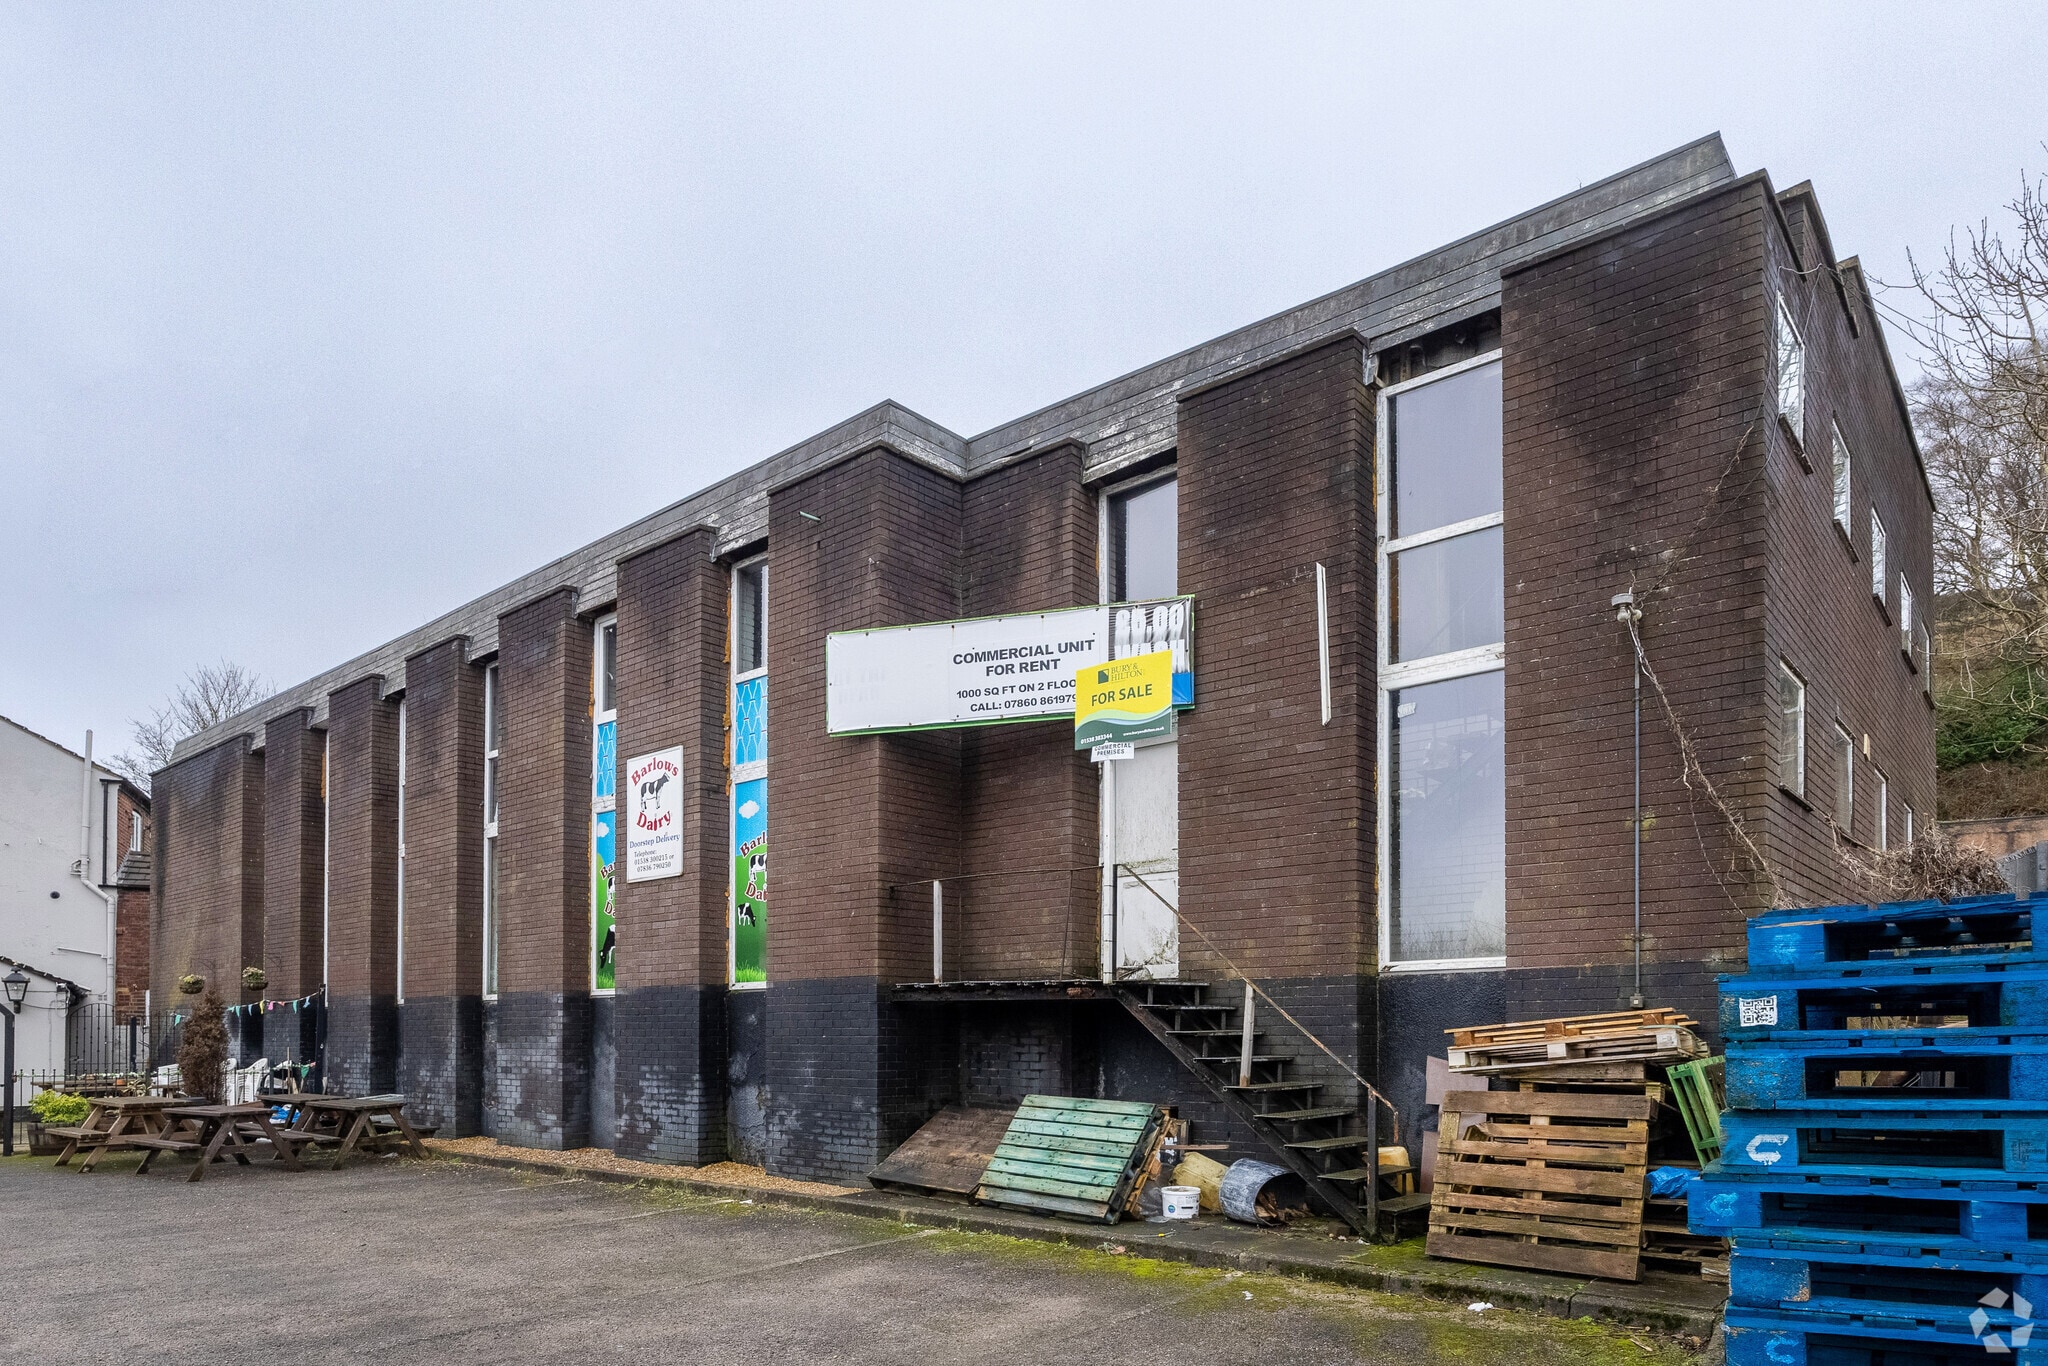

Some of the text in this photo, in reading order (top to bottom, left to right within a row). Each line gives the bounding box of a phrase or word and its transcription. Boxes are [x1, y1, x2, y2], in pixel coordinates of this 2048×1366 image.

[953, 639, 1095, 665] COMMERCIAL UNIT
[986, 658, 1061, 676] FOR RENT
[1111, 664, 1131, 674] BURY
[1111, 669, 1143, 682] HILTON
[957, 688, 981, 699] 1000
[984, 687, 999, 697] SQ
[1002, 685, 1016, 695] FT
[1019, 683, 1035, 693] ON
[1038, 682, 1044, 691] 2
[1091, 684, 1153, 706] FOR SALE
[970, 702, 1002, 712] CALL:
[1005, 697, 1037, 709] 07860
[1094, 743, 1132, 752] COMMERCIAL
[1097, 748, 1125, 756] PREMISES
[631, 757, 679, 786] Barlows
[636, 811, 672, 832] Dairy
[629, 832, 681, 849] Doorstep Delivery
